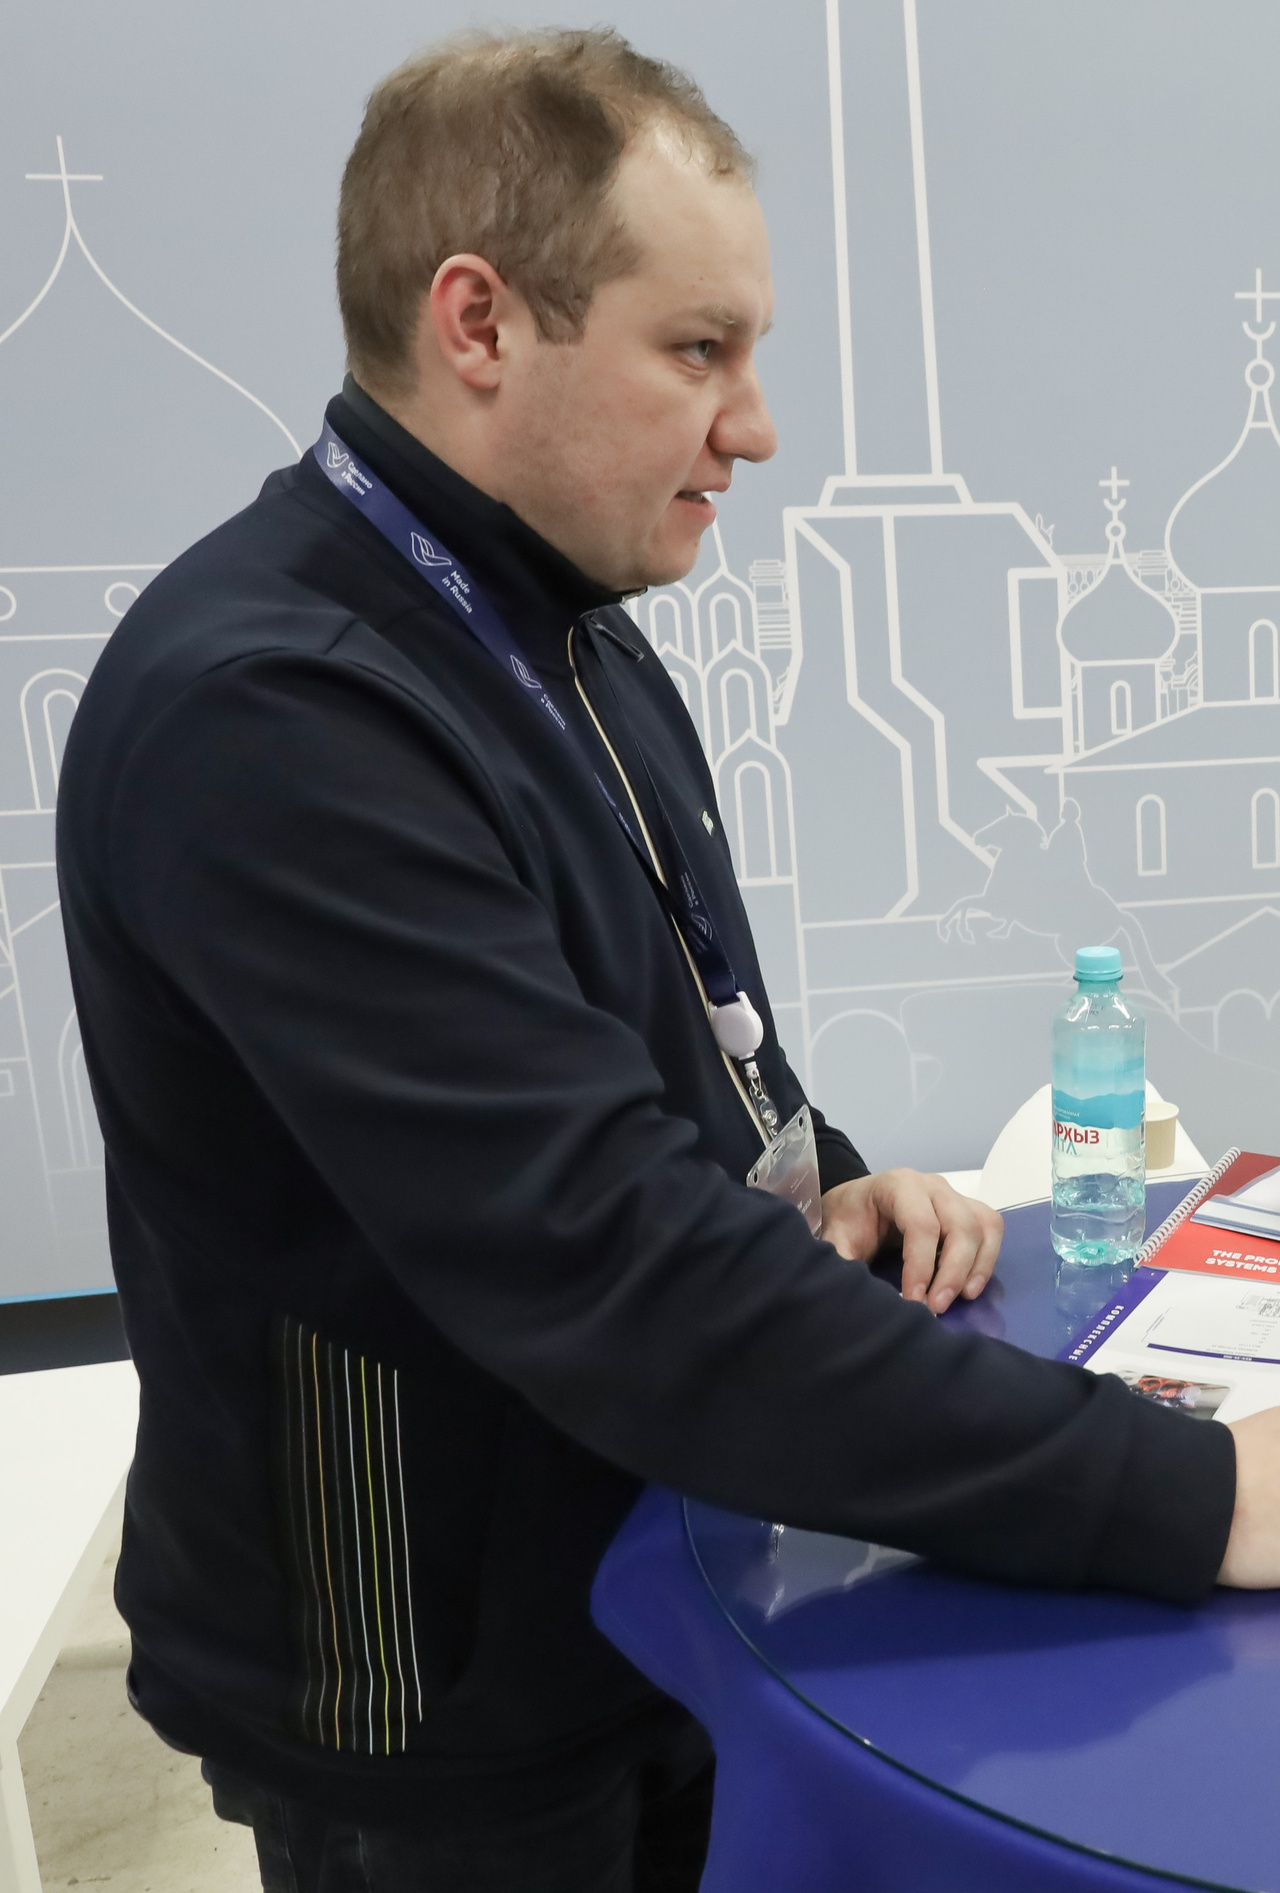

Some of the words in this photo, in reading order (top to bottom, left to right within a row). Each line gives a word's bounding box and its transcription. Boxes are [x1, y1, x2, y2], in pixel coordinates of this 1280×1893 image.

[450, 570, 471, 594] Made
[441, 576, 451, 588] in
[450, 585, 473, 614] Russia
[1205, 1257, 1278, 1274] SYSTEMS
[1212, 1249, 1242, 1260] THE
[1068, 1304, 1125, 1361] КОМПЛЕКСНЫЕ
